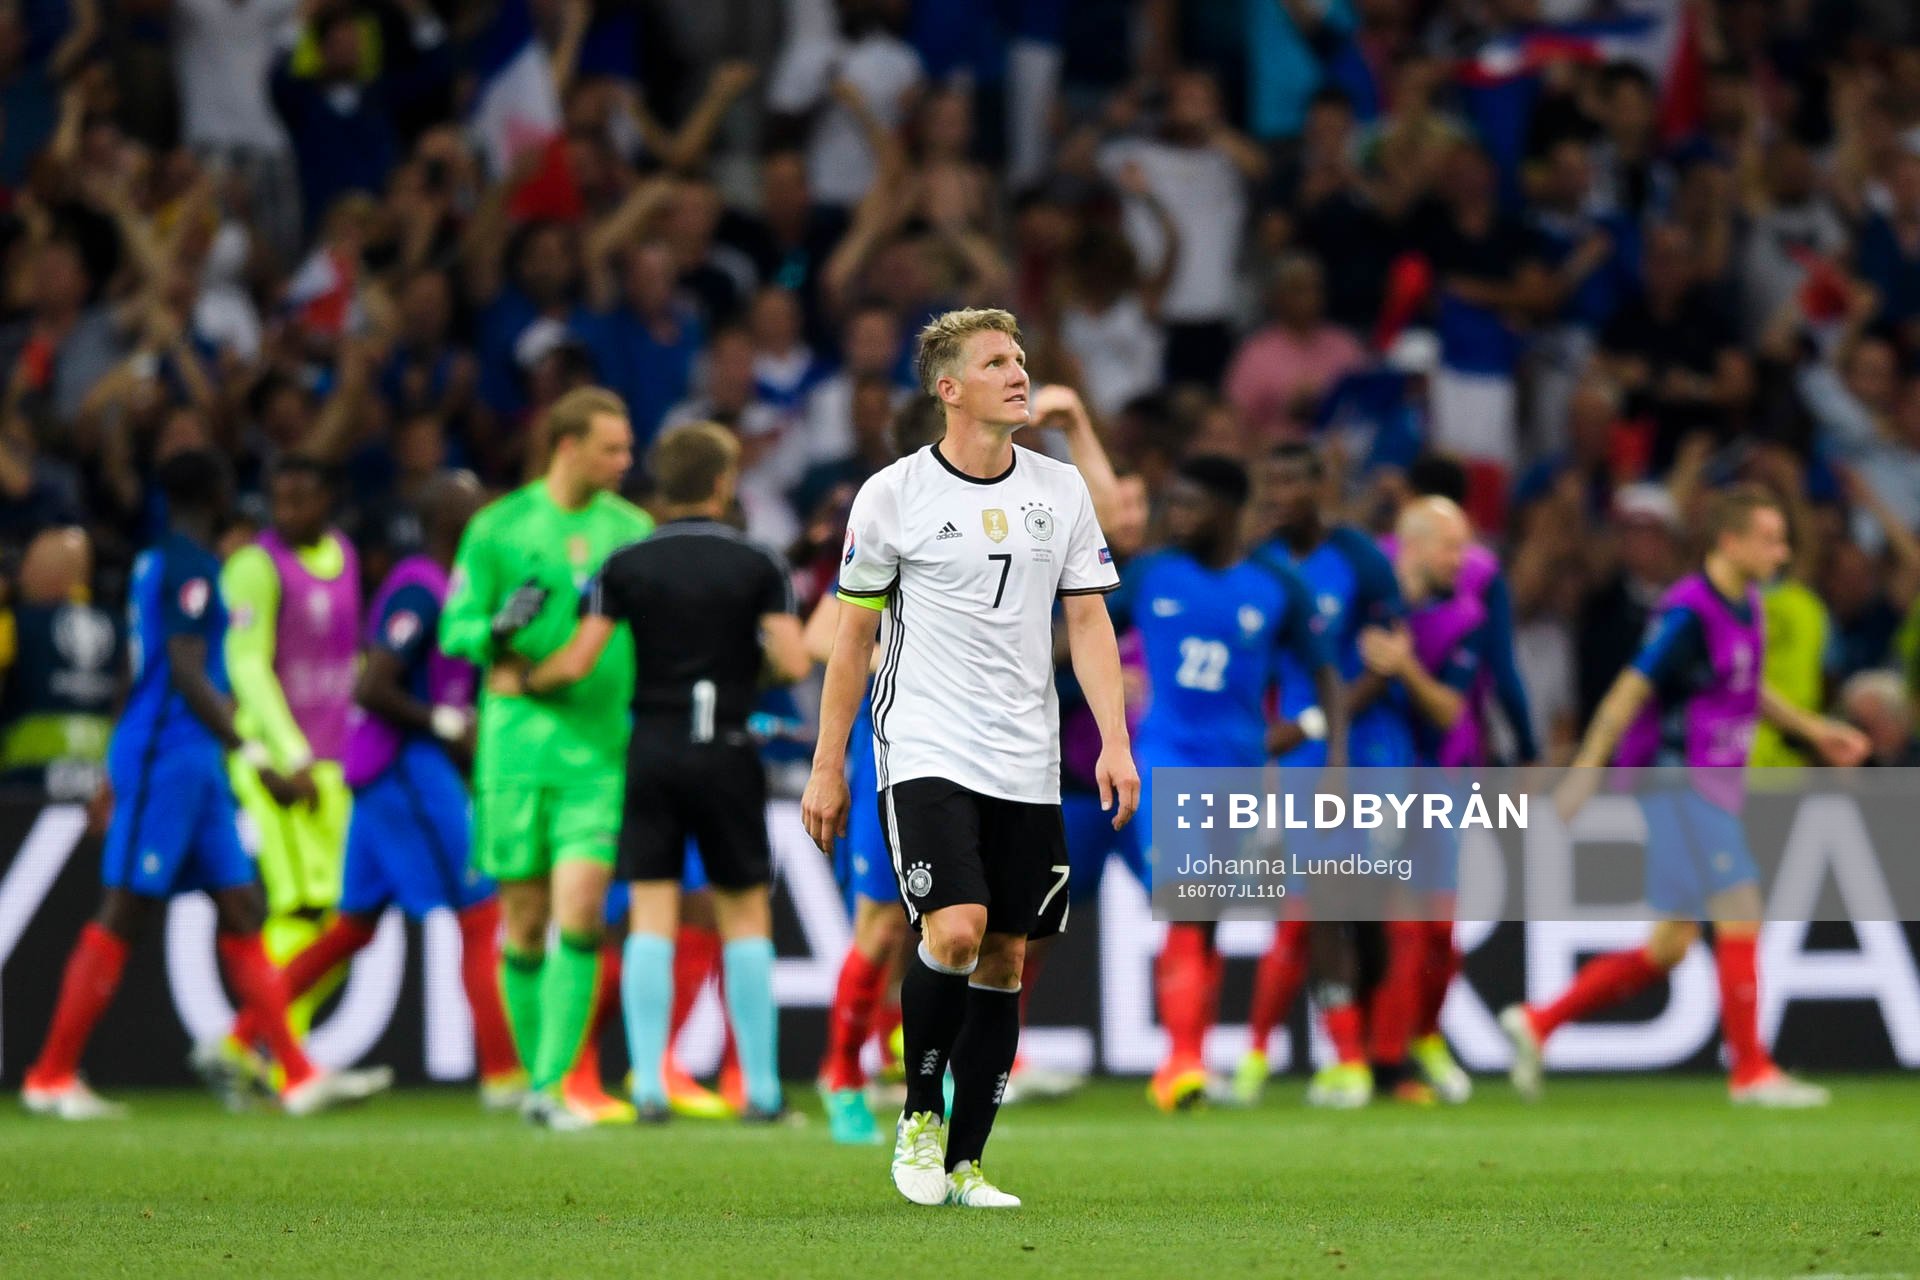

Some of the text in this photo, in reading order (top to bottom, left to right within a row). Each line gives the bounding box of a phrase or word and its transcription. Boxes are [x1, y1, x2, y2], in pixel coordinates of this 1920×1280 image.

[936, 532, 963, 541] adidas
[988, 554, 1012, 608] 7
[1176, 636, 1229, 691] 22
[1037, 865, 1070, 916] 7
